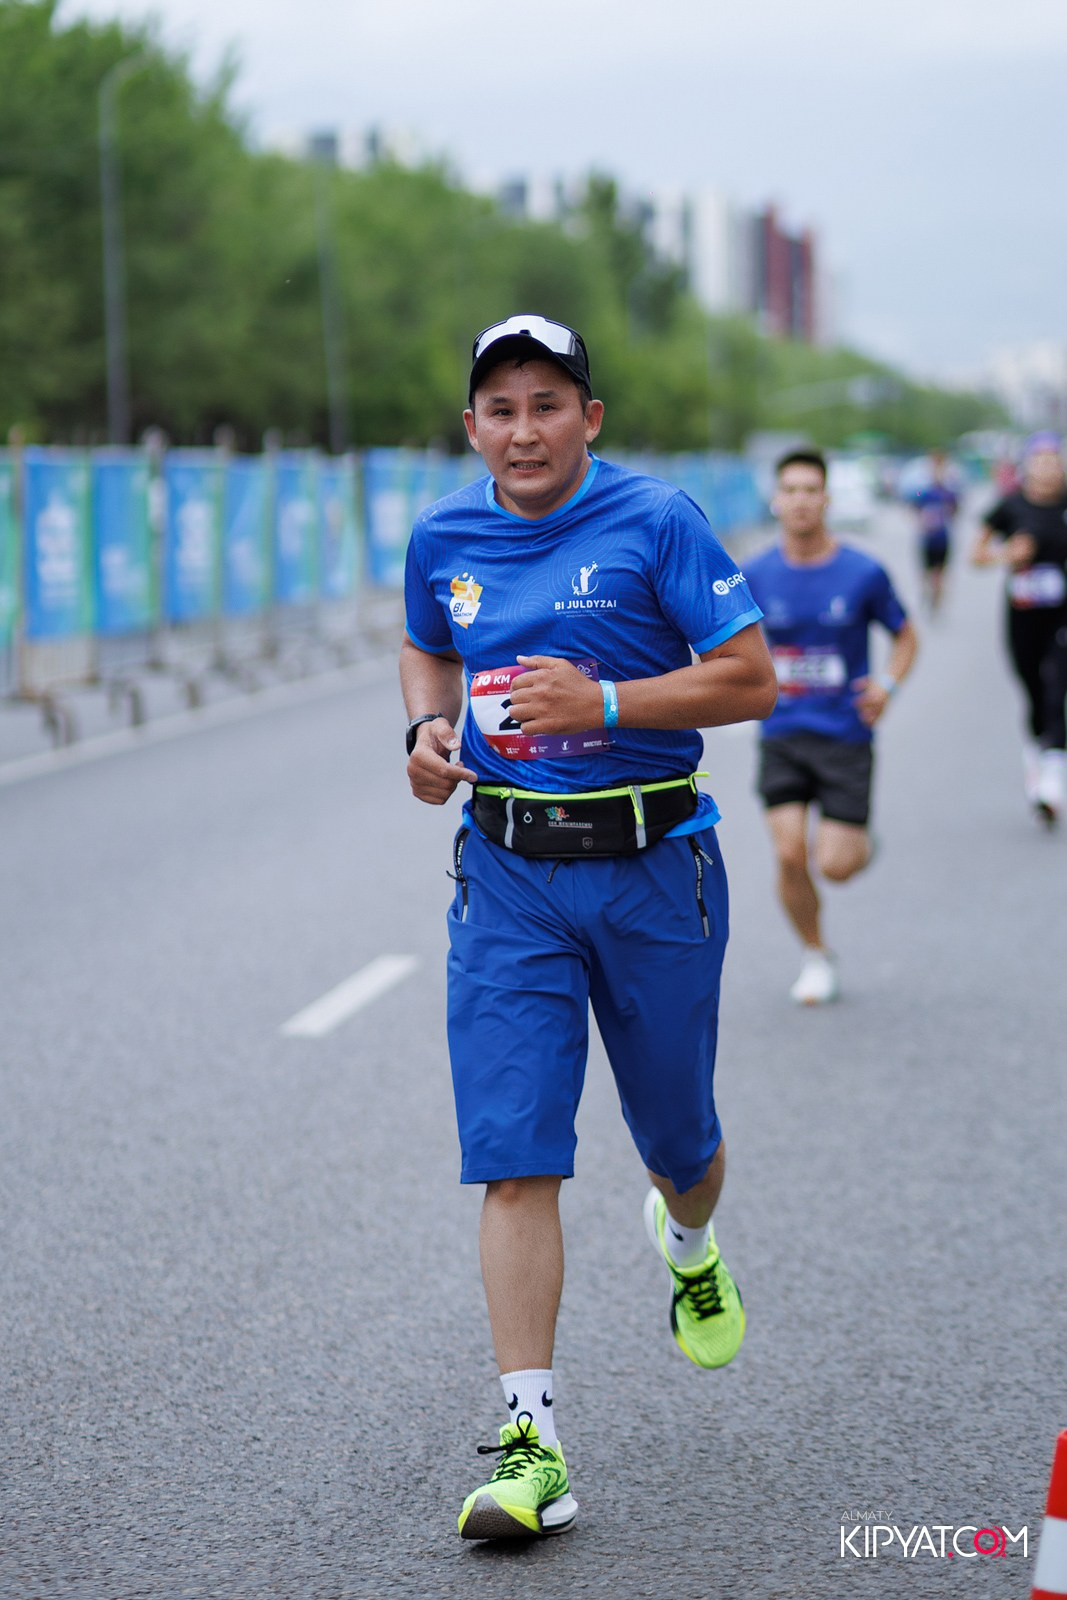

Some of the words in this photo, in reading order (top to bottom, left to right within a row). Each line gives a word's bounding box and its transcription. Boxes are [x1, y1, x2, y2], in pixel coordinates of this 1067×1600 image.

[453, 602, 465, 613] BI
[554, 601, 565, 610] BI
[566, 600, 617, 609] JULDYZAI
[477, 674, 491, 687] 10
[493, 674, 511, 685] KM
